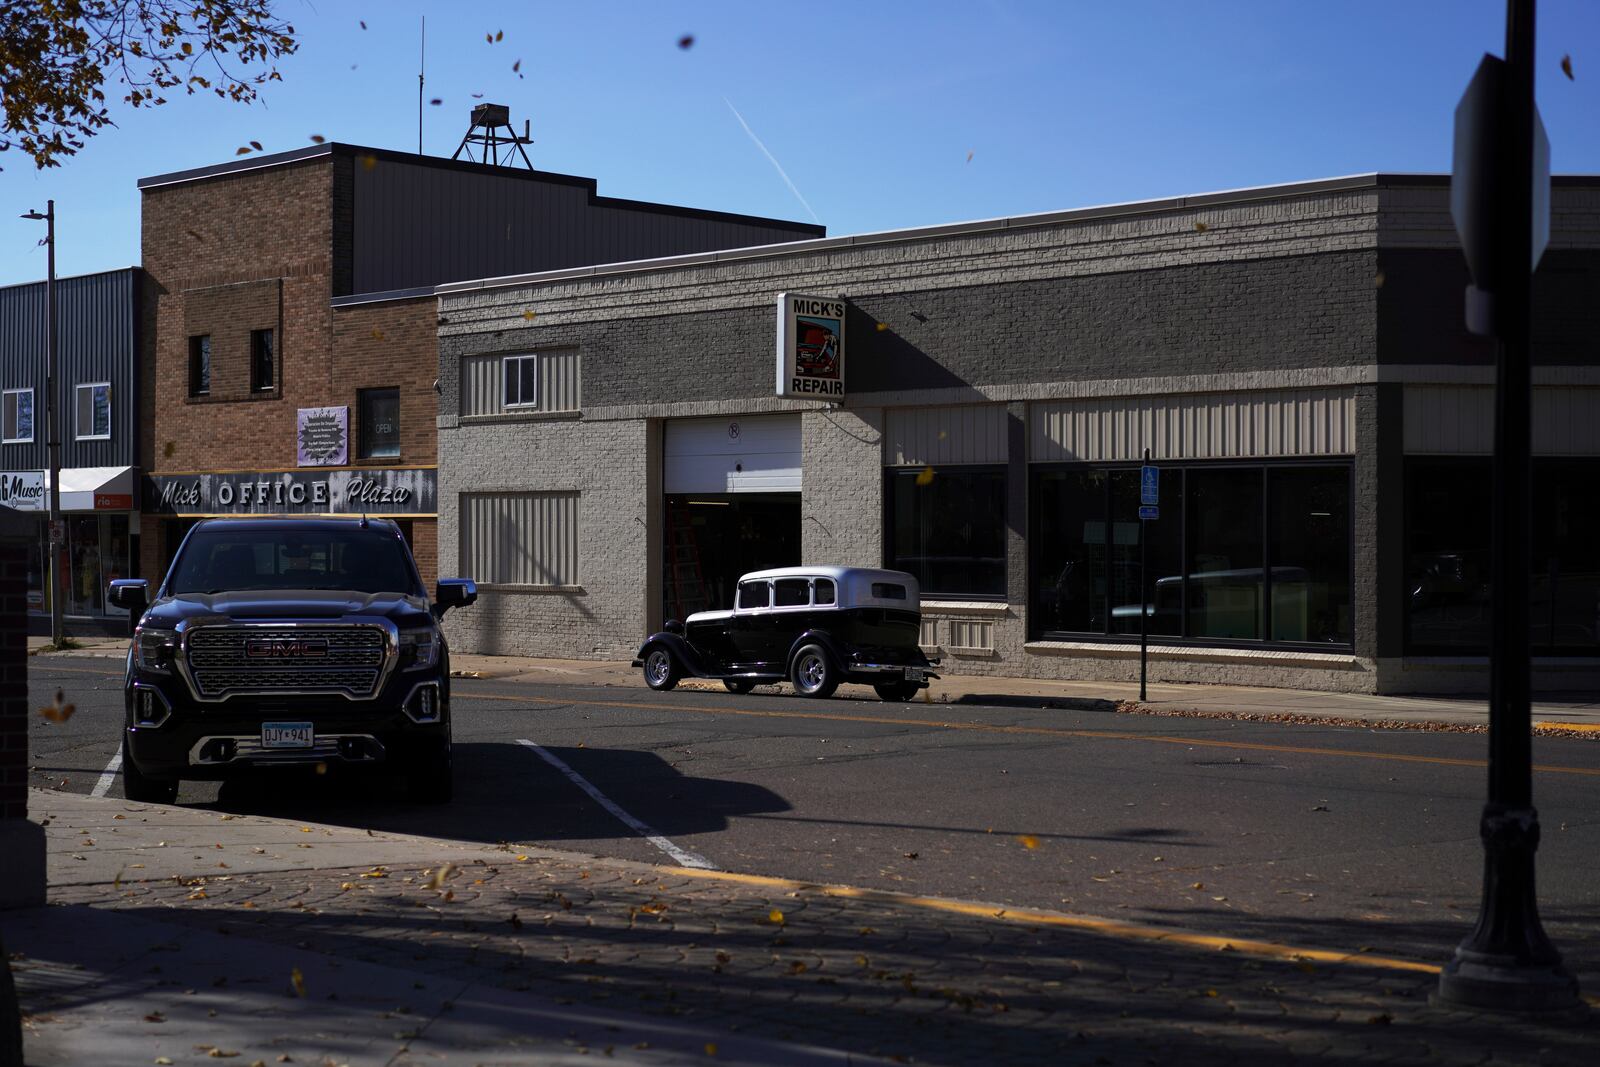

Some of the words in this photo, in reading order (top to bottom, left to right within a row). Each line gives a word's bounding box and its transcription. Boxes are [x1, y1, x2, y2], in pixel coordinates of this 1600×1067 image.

[793, 299, 844, 317] MICK'S
[792, 378, 843, 395] REPAIR
[9, 475, 43, 499] Music
[159, 480, 200, 506] Mick
[218, 481, 328, 505] OFFICE
[346, 477, 410, 505] Plaza
[247, 641, 327, 657] GMC
[291, 729, 310, 741] 941
